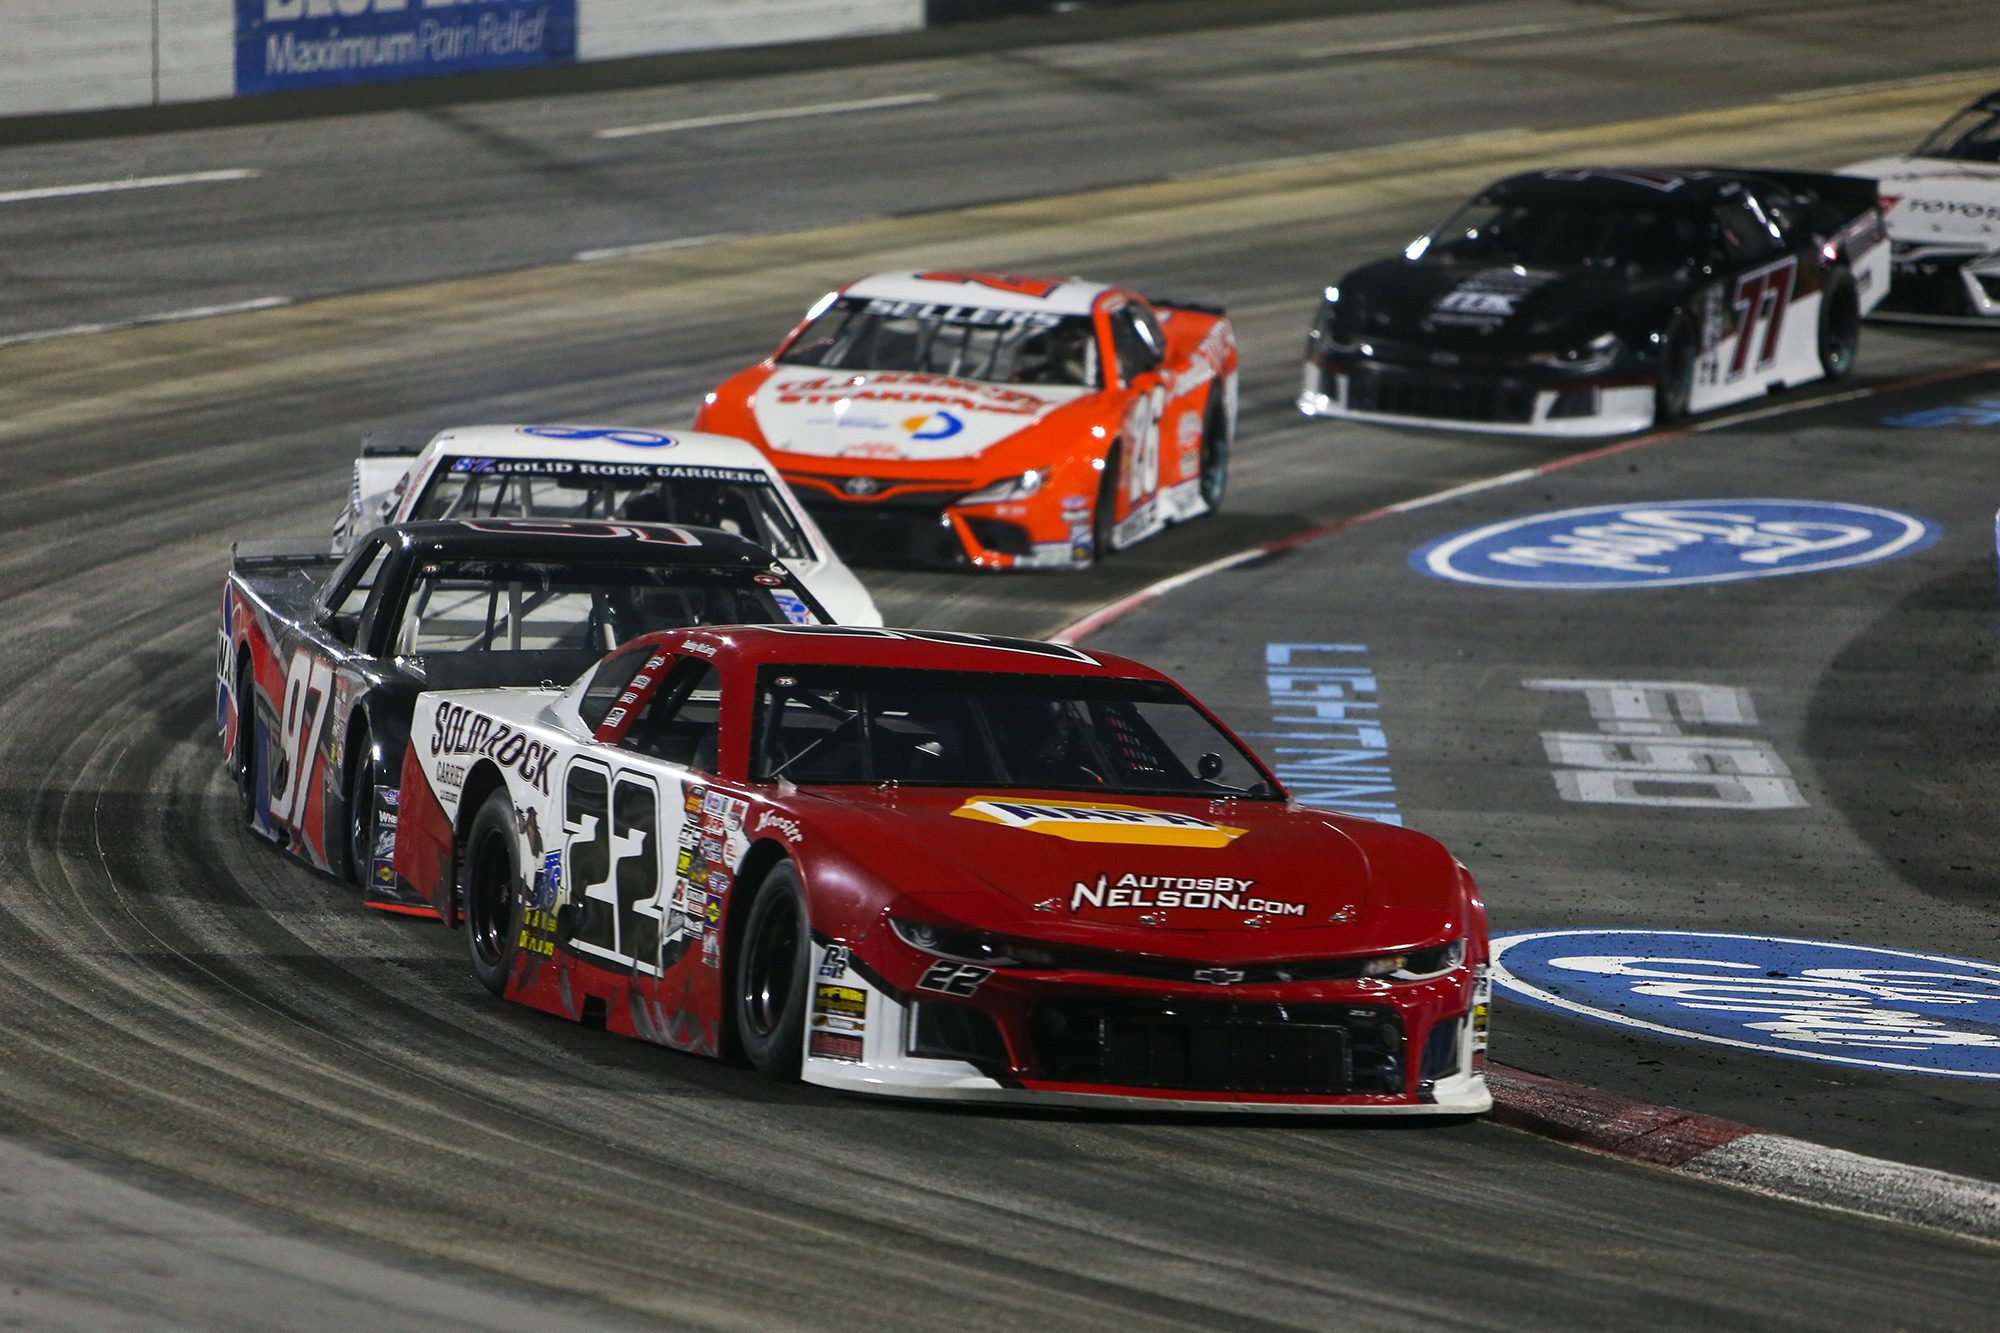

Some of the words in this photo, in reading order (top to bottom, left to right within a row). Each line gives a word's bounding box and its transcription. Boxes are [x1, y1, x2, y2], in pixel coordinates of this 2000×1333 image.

[264, 27, 419, 75] Maximum
[419, 17, 475, 63] Pain
[476, 6, 549, 53] Relief
[862, 299, 1062, 327] SELLERS
[1725, 254, 1798, 385] 77
[497, 462, 573, 474] SOLID
[579, 464, 652, 477] ROCK
[656, 466, 769, 483] CARRIERS
[1488, 509, 1873, 575] Ford
[269, 648, 336, 832] 97
[431, 700, 492, 758] SOLID
[478, 723, 559, 798] ROCK
[1258, 643, 1403, 827] LIGHTNIN
[754, 809, 804, 843] Hoosier
[562, 753, 664, 979] 22
[915, 959, 996, 998] 22
